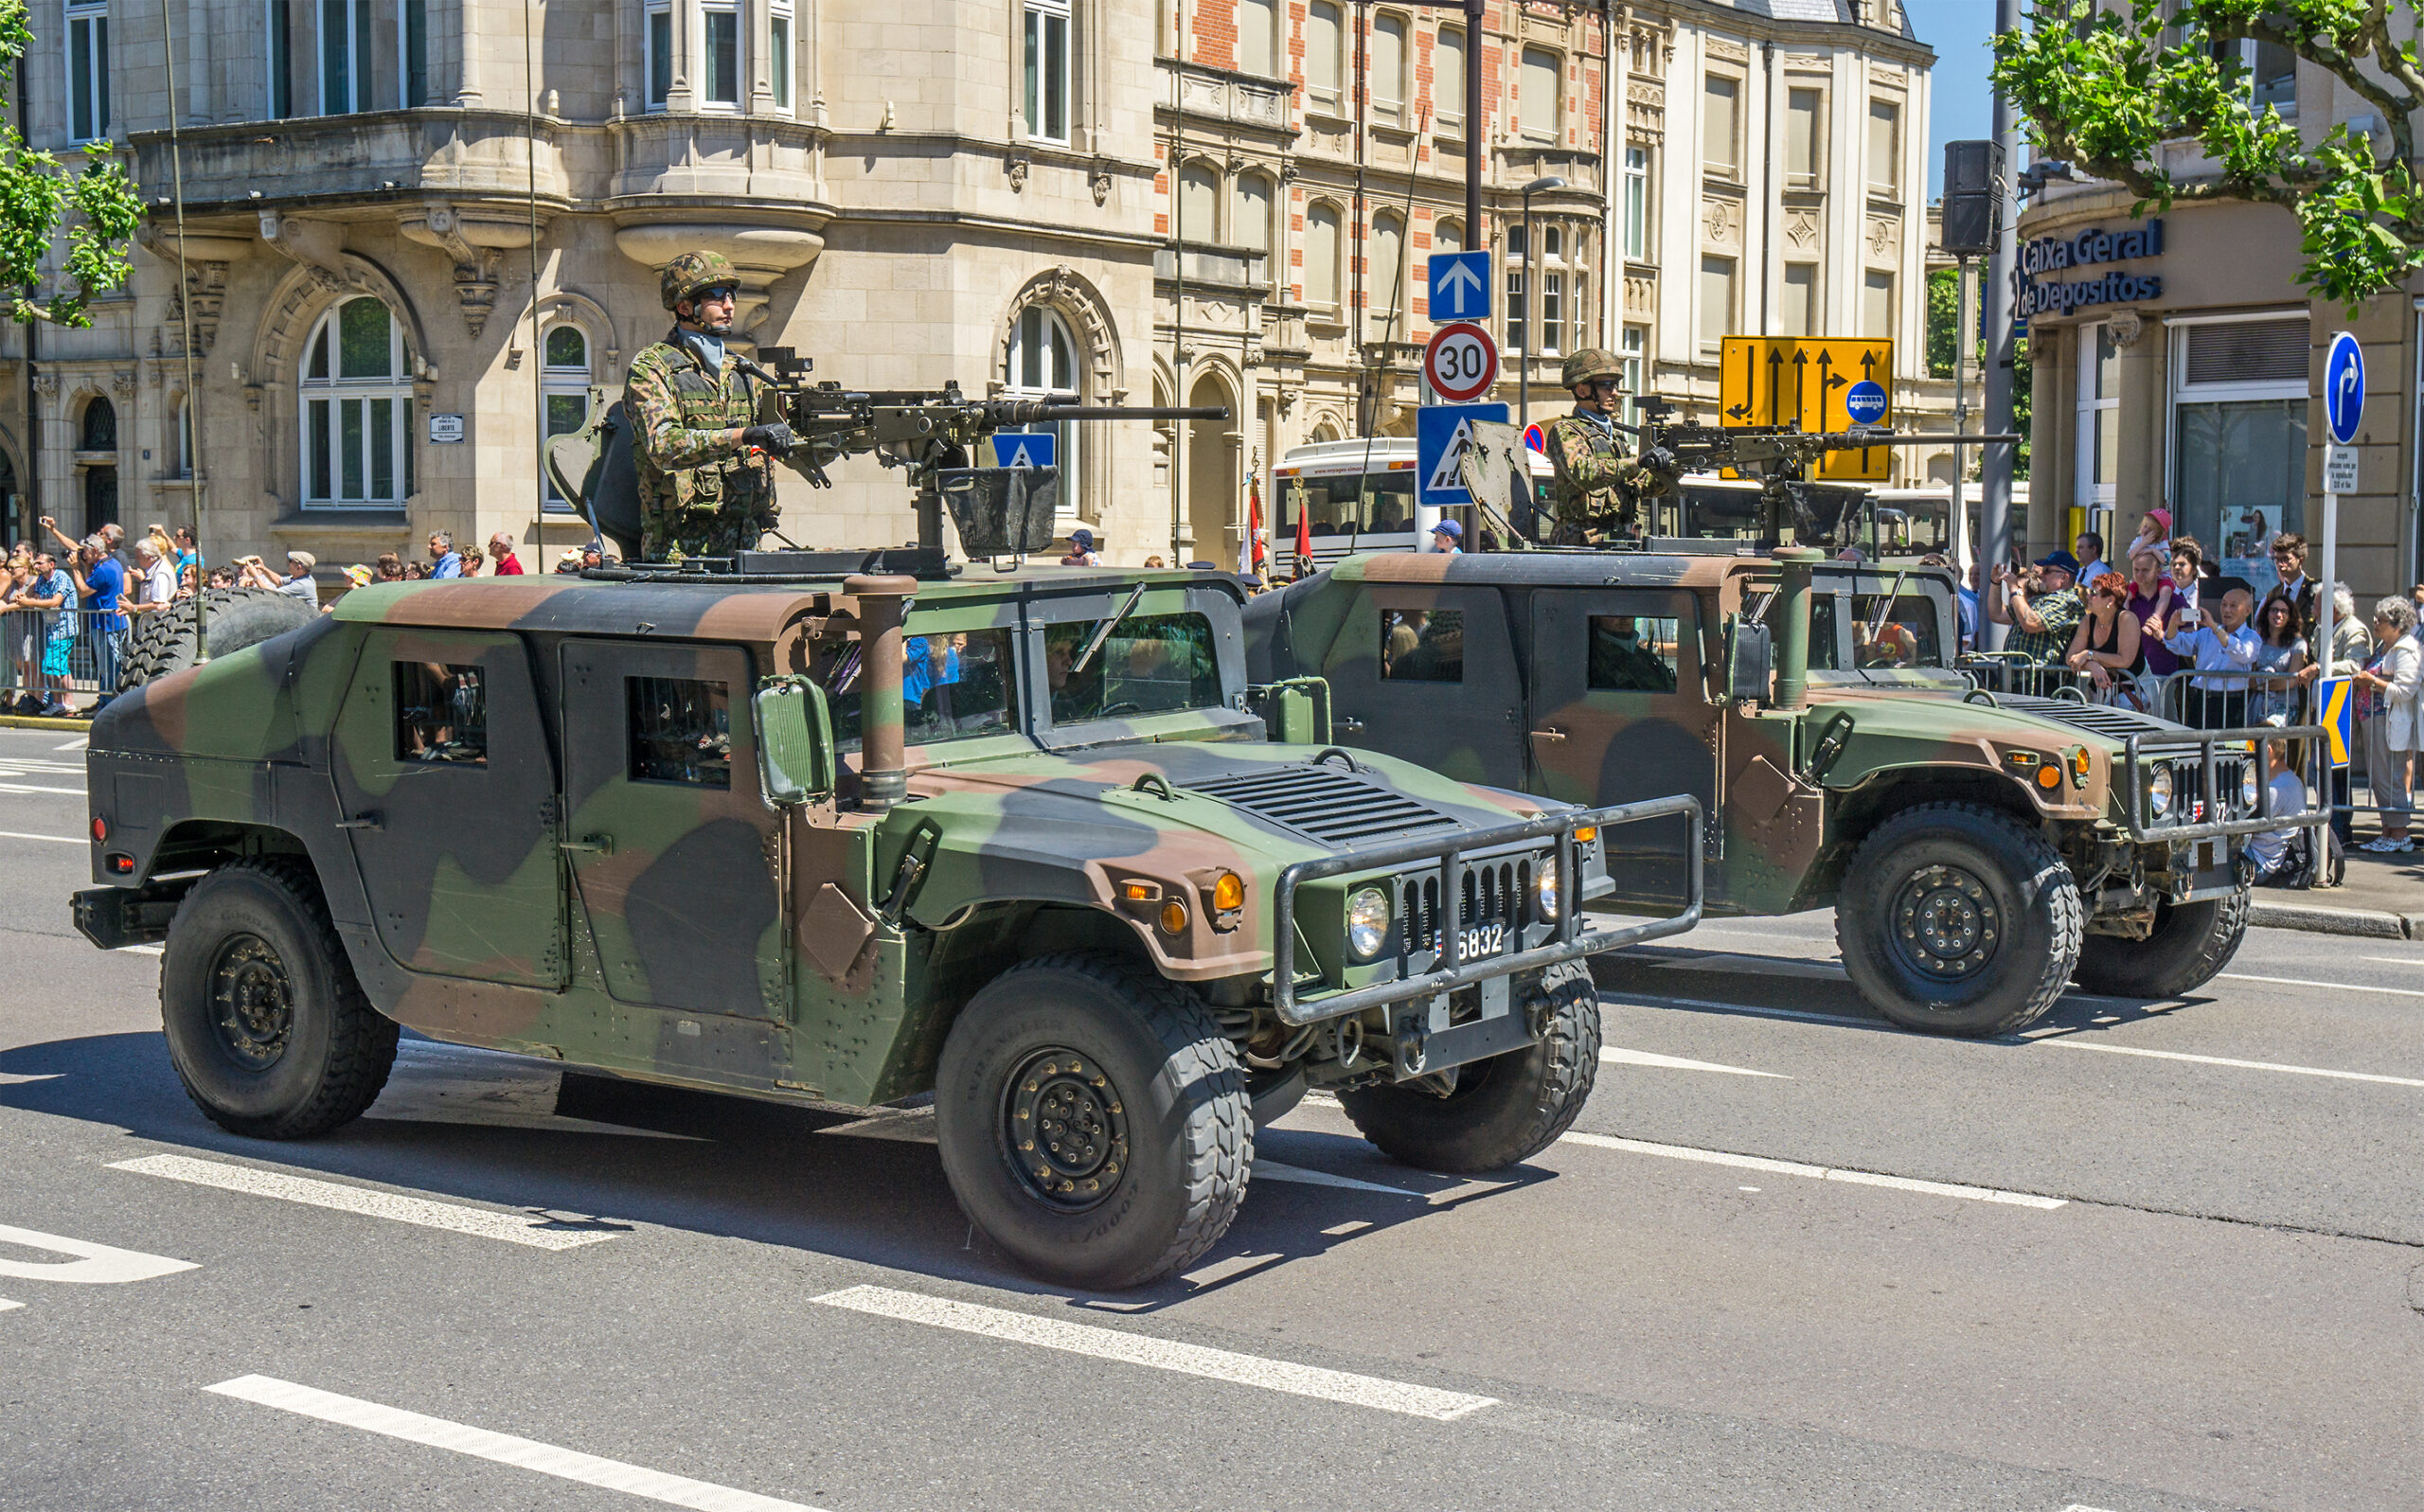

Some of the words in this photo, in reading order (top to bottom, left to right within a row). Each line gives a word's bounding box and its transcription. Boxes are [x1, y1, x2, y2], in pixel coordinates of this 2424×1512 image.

[2023, 237, 2069, 276] Caixa
[2074, 219, 2159, 264] Geral
[2022, 284, 2036, 316] de
[1440, 344, 1481, 381] 30
[1459, 923, 1503, 960] 6832
